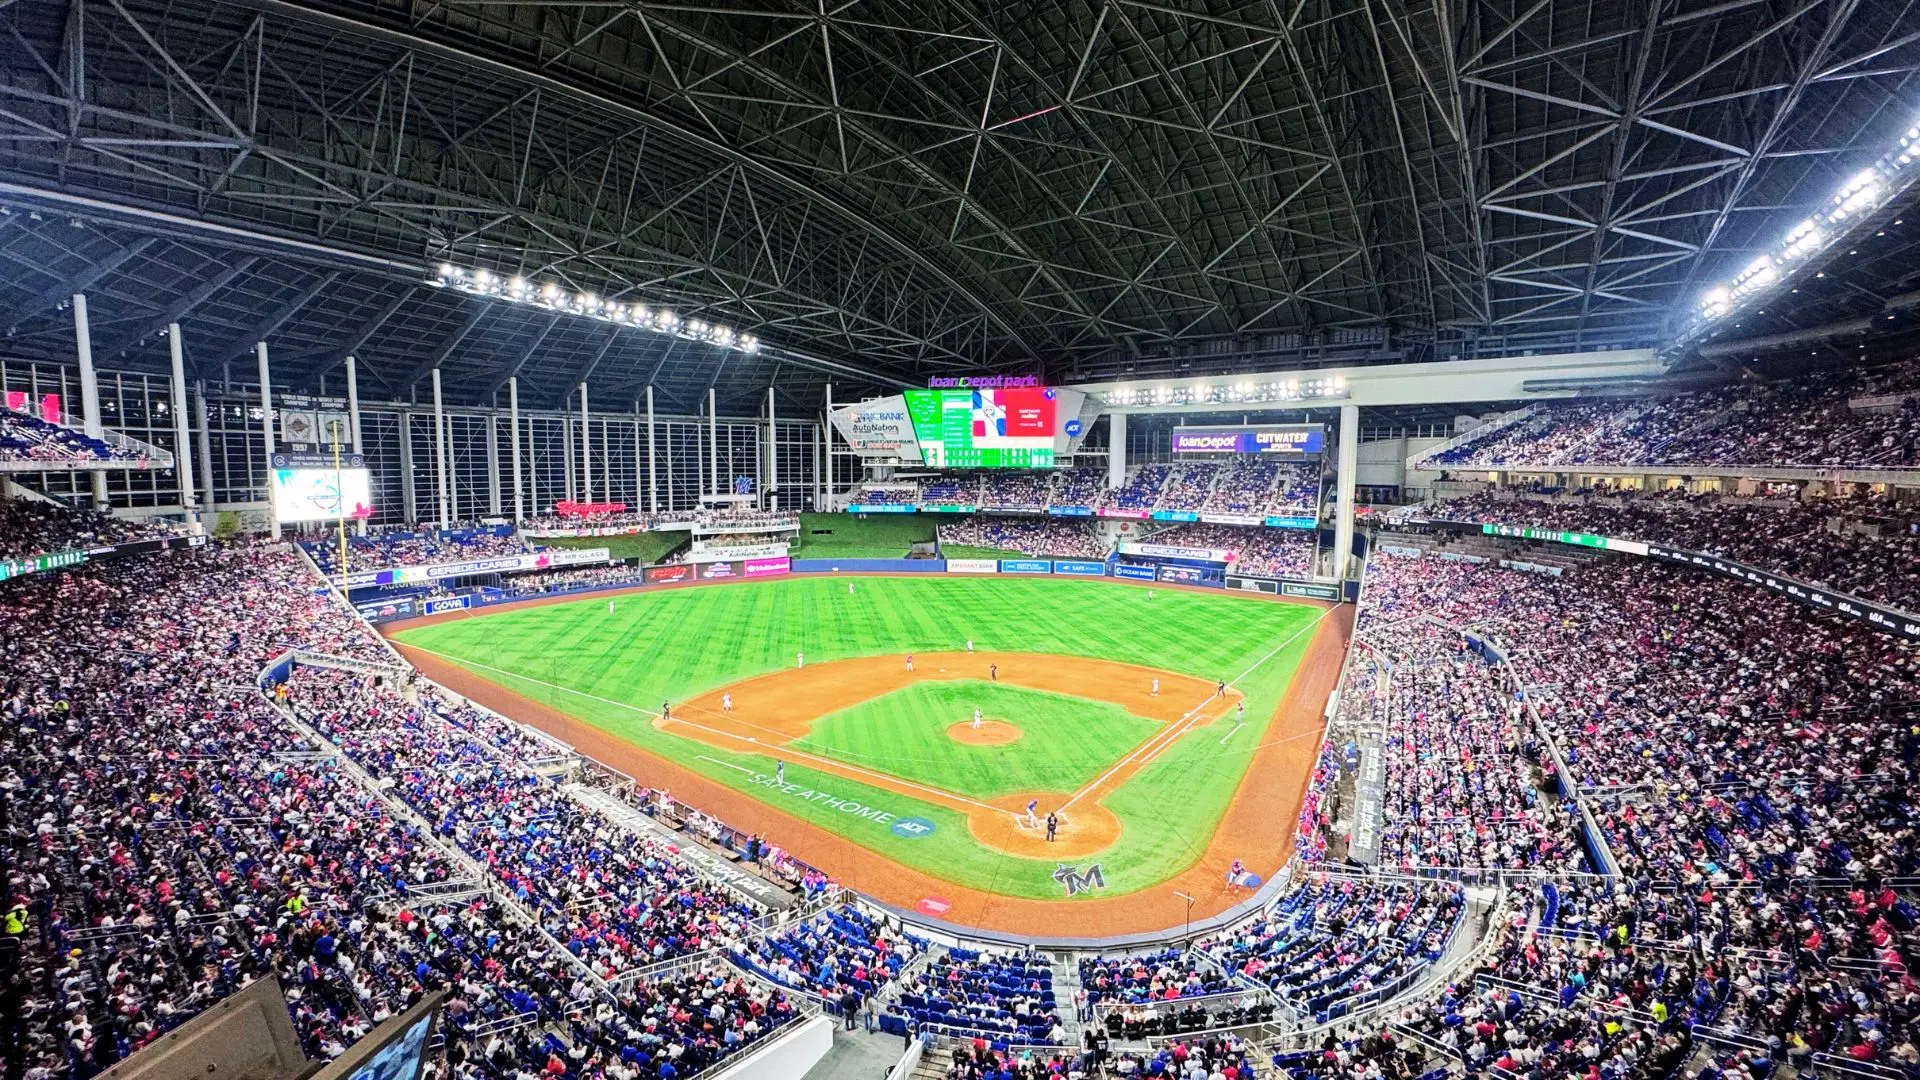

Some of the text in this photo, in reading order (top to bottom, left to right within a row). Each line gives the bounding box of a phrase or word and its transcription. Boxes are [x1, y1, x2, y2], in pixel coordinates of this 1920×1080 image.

[931, 375, 1036, 389] loanDepot park
[880, 412, 904, 420] BANK
[853, 424, 898, 432] AutoNation
[1178, 436, 1236, 449] loanDepot
[1256, 433, 1309, 443] CUTWATER
[433, 600, 463, 610] GOYA
[748, 774, 896, 825] SAFE AT HOME
[896, 821, 930, 834] ADT
[732, 877, 772, 896] park
